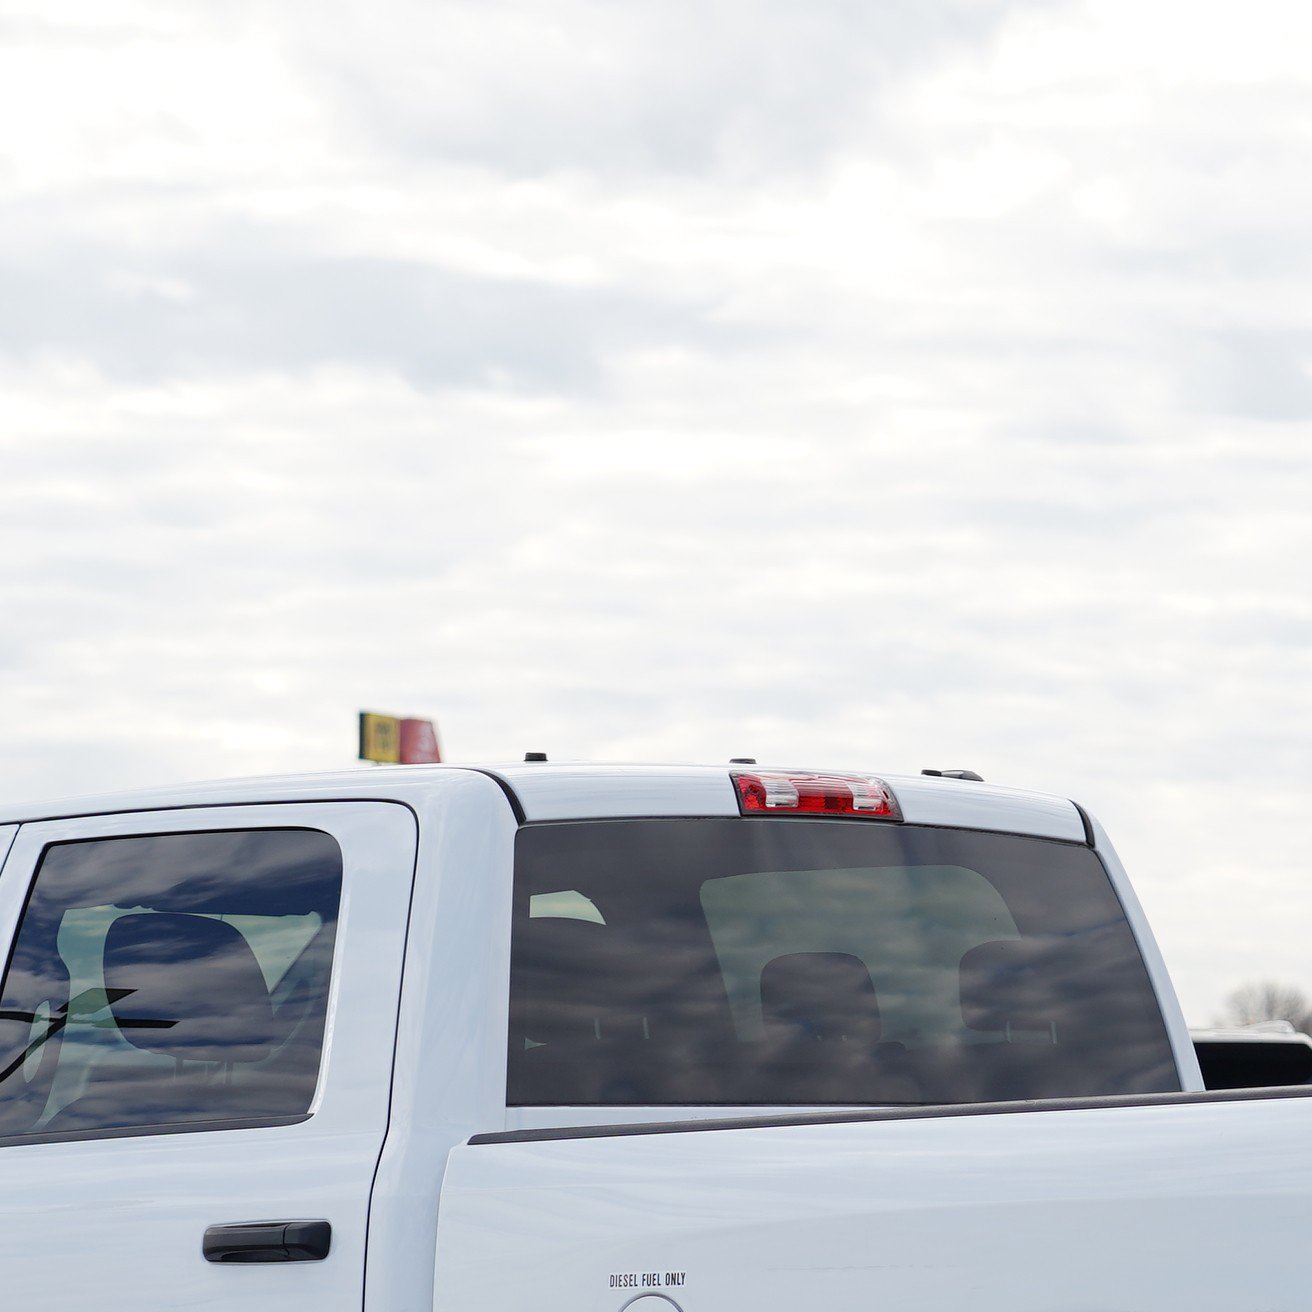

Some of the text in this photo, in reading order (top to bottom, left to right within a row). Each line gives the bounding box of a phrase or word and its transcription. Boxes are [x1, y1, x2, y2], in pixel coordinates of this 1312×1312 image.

[609, 1272, 686, 1287] DIESEL FUEL ONLY
